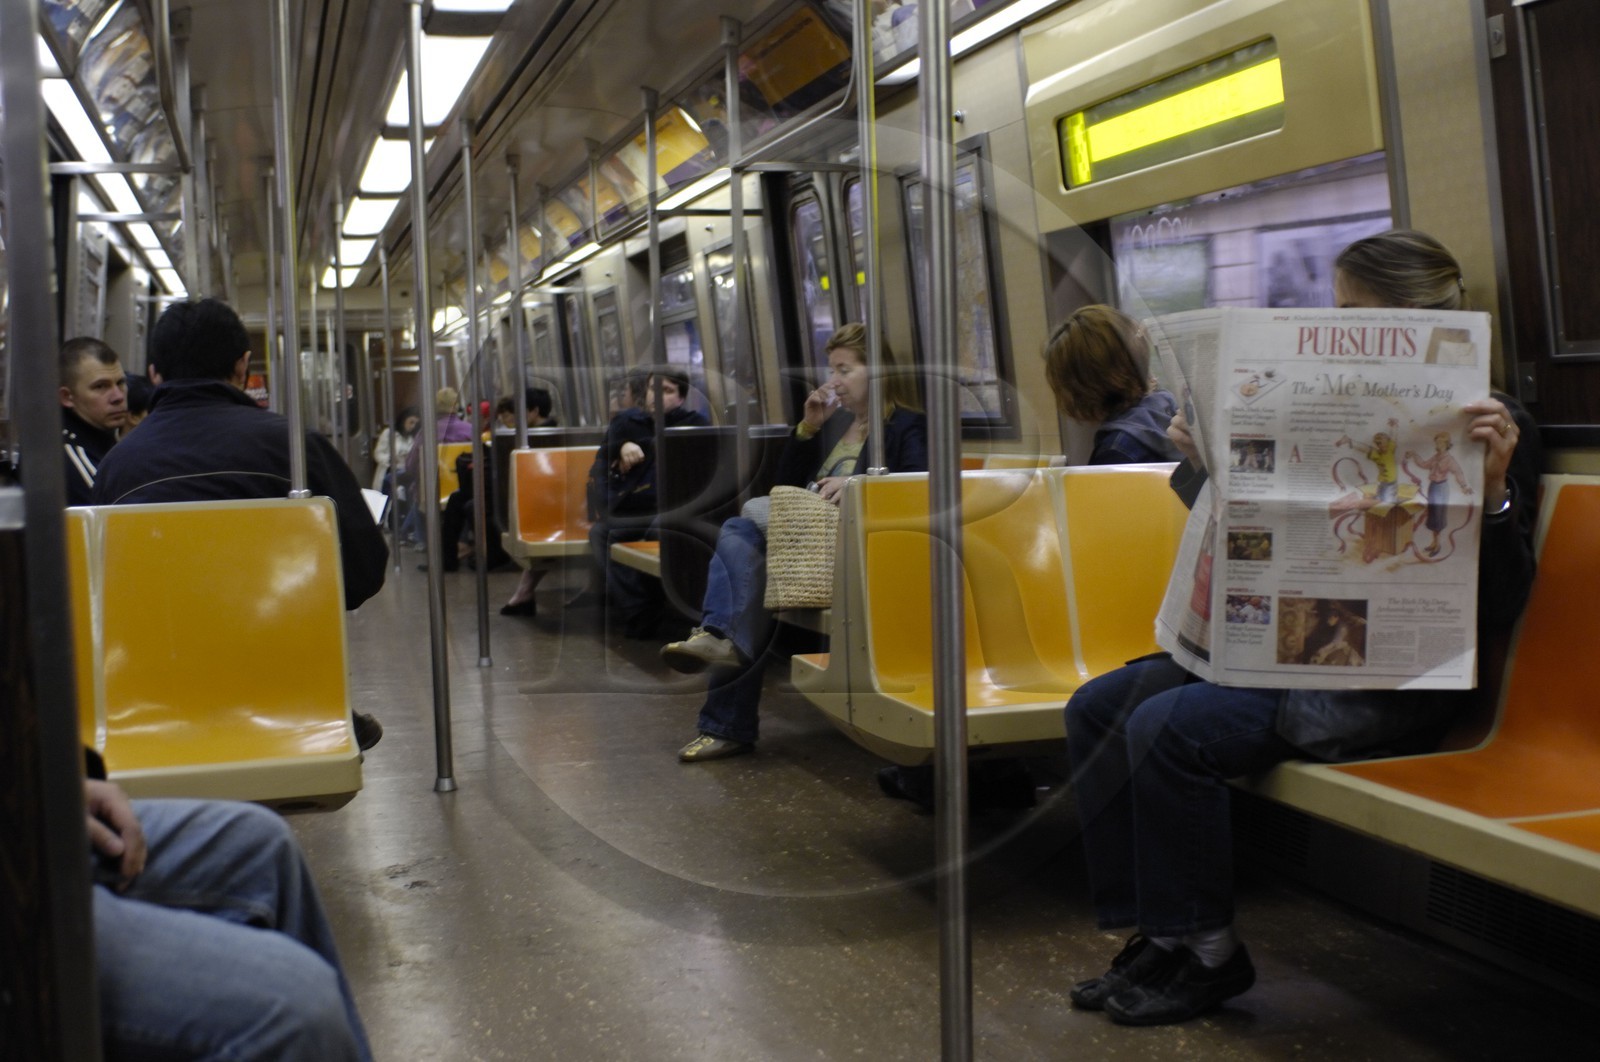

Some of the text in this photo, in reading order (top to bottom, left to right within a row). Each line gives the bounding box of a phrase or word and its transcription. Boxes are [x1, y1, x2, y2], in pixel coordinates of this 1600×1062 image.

[1296, 326, 1417, 358] PURSUITS
[1291, 381, 1316, 395] The
[1361, 381, 1420, 398] Mother's
[1423, 383, 1455, 402] Day
